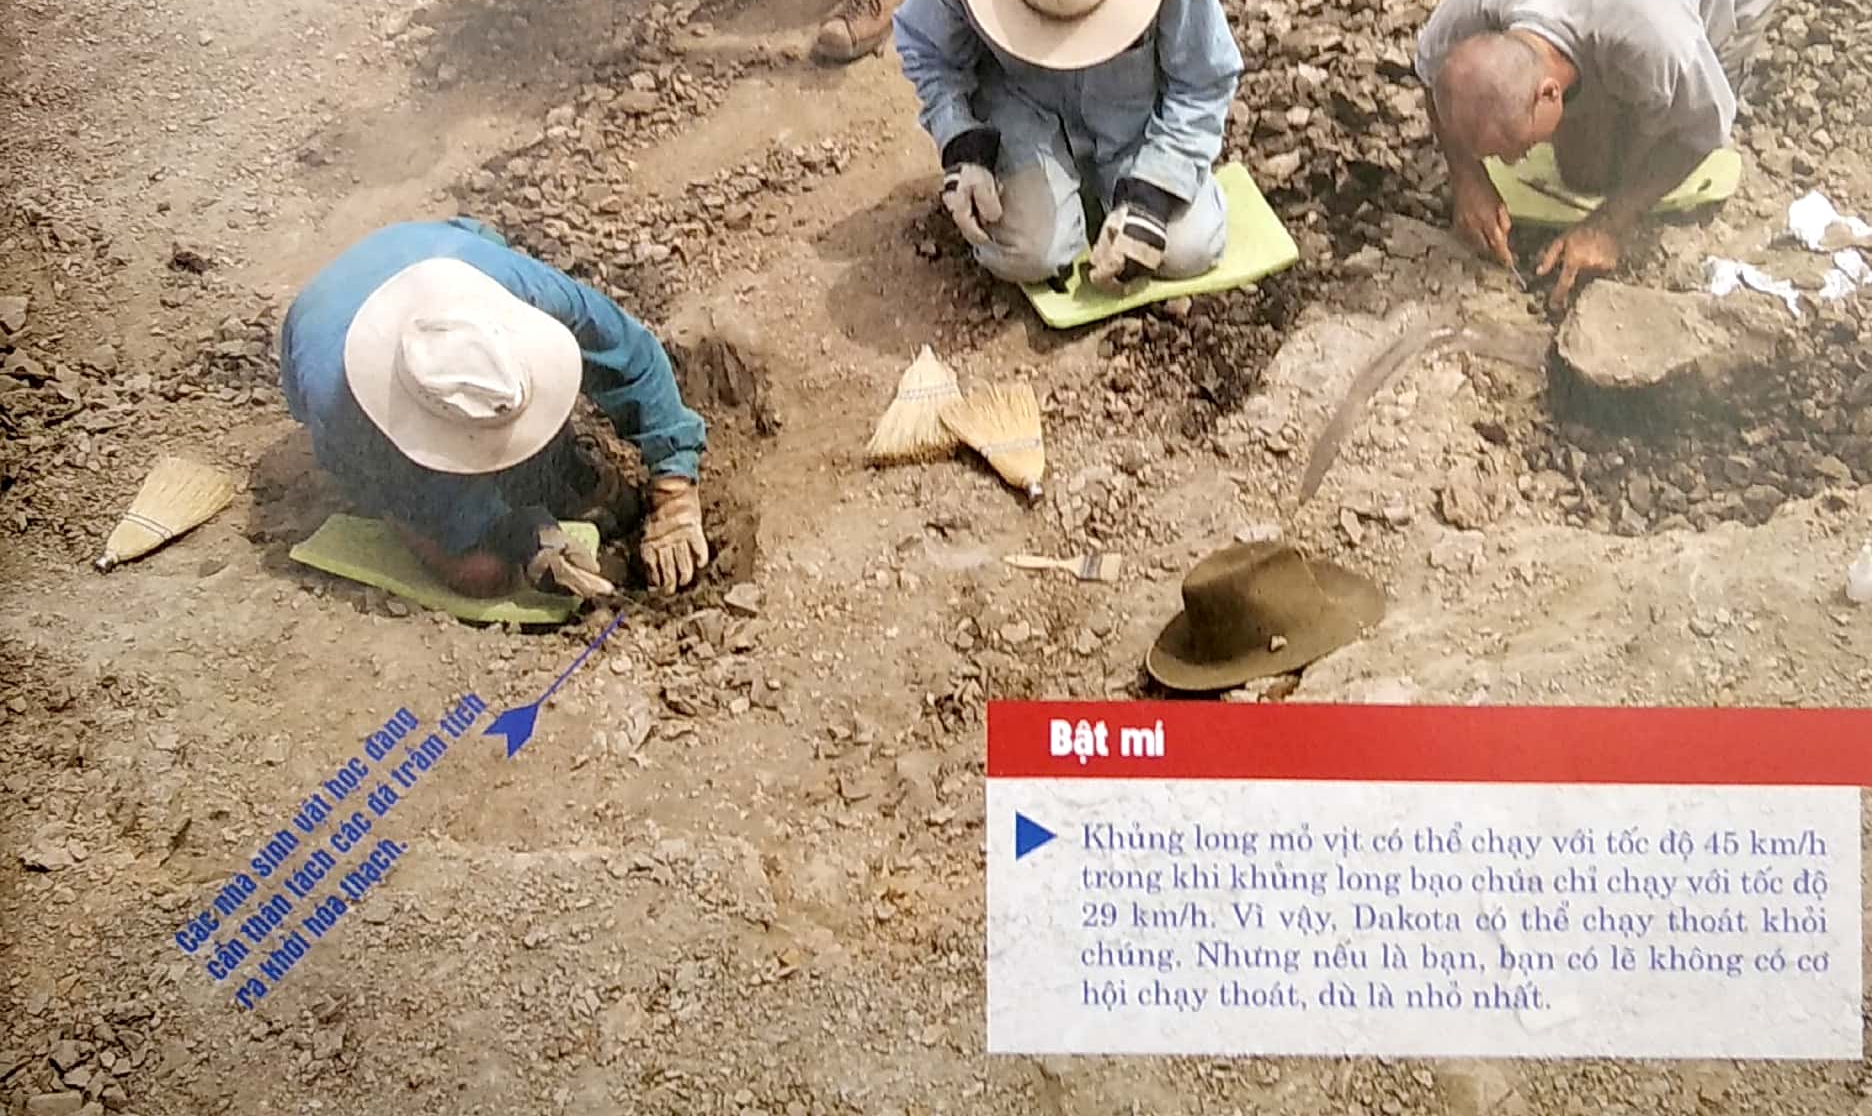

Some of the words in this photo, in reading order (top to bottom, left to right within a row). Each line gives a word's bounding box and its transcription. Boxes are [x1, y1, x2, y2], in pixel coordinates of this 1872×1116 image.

[1050, 718, 1109, 764] Bật
[207, 935, 250, 982] cẩn
[241, 893, 293, 944] thận
[285, 848, 336, 899] tách
[330, 811, 373, 855] các
[367, 782, 401, 818] đá
[391, 734, 449, 790] trầm
[441, 692, 488, 739] tích
[213, 873, 258, 916] nhà
[250, 828, 301, 879] sinh
[294, 793, 333, 835] vật
[324, 755, 370, 802] học
[1082, 822, 1185, 856] Khủng
[1195, 824, 1257, 855] long
[1269, 823, 1313, 851] mỏ
[1322, 827, 1363, 858] vịt
[1372, 826, 1403, 852] có
[1412, 820, 1464, 854] thể
[1472, 828, 1542, 859] chạy
[1553, 828, 1595, 854] với
[1606, 826, 1649, 854] tốc
[1659, 829, 1694, 861] độ
[1704, 831, 1739, 856] 45
[1751, 830, 1827, 856] km/h
[1082, 865, 1162, 896] trong
[1173, 863, 1219, 890] khi
[1230, 862, 1327, 896] khủng
[1337, 864, 1401, 896] long
[1410, 866, 1463, 897] bạo
[1472, 868, 1544, 894] chúa
[1553, 865, 1597, 893] chỉ
[1606, 868, 1678, 899] chạy
[1688, 868, 1729, 894] với
[1741, 866, 1784, 894] tốc
[1793, 868, 1828, 900] độ
[236, 976, 268, 1012] ra
[259, 932, 312, 983] khỏi
[303, 894, 348, 938] hóa
[341, 835, 409, 902] thạch.
[1081, 903, 1116, 928] 29
[1133, 901, 1215, 929] km/h.
[1235, 901, 1263, 928] Vì
[1280, 905, 1337, 936] vậy,
[1353, 904, 1460, 931] Dakota
[1476, 907, 1507, 932] có
[1521, 902, 1570, 932] thể
[1582, 907, 1654, 938] chạy
[1668, 908, 1748, 933] thoát
[1763, 907, 1827, 933] khỏi
[1081, 941, 1182, 972] chúng.
[1197, 941, 1301, 972] Nhưng
[1313, 939, 1367, 969] nếu
[1382, 943, 1409, 968] là
[1421, 943, 1486, 974] bạn,
[1499, 945, 1554, 974] bạn
[1568, 947, 1598, 970] có
[1611, 946, 1636, 971] lẽ
[1649, 946, 1744, 977] không
[1754, 947, 1786, 971] có
[1797, 952, 1829, 972] cơ
[1082, 981, 1126, 1013] hội
[1138, 982, 1207, 1012] chạy
[1220, 983, 1307, 1011] thoát,
[1318, 983, 1356, 1007] dù
[1368, 983, 1394, 1007] là
[1405, 981, 1462, 1008] nhỏ
[1472, 981, 1551, 1010] nhất.
